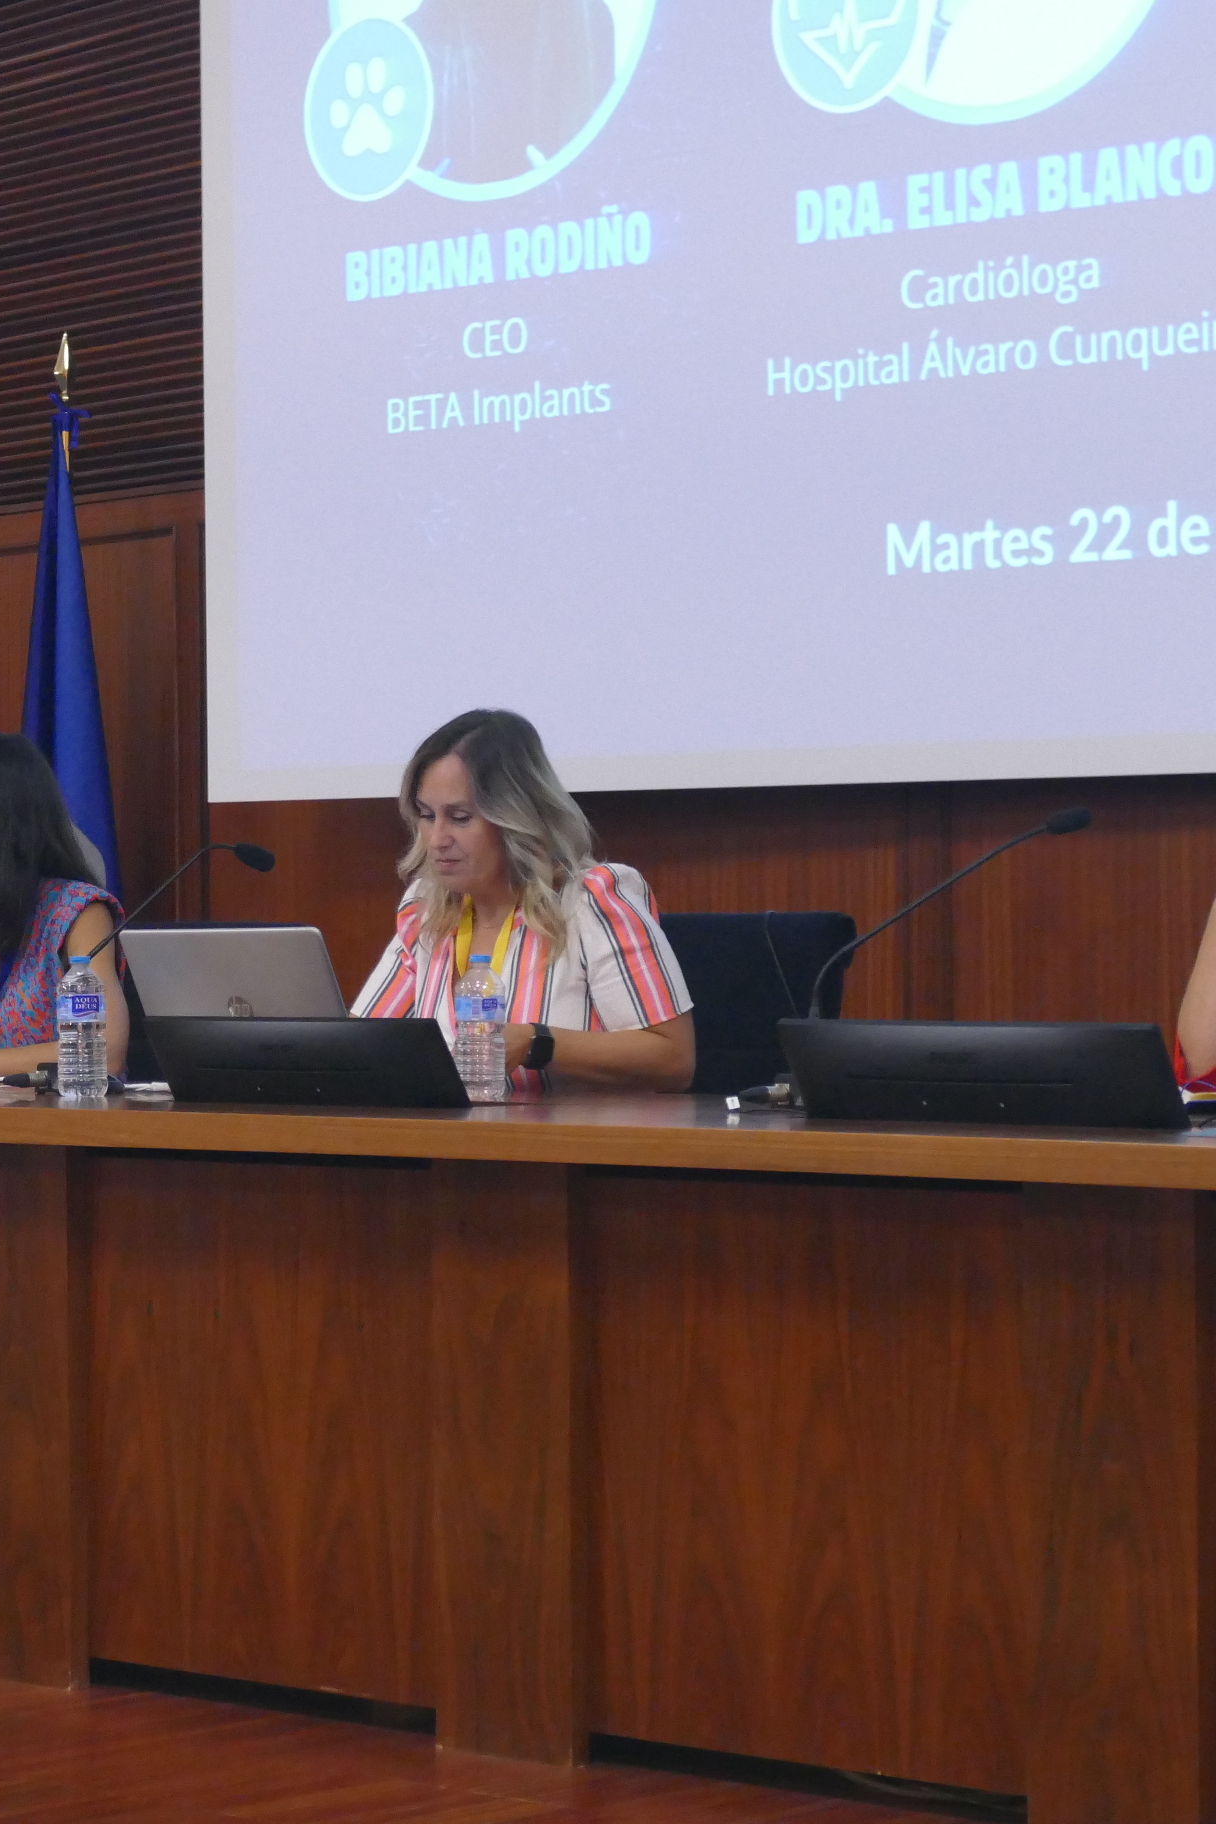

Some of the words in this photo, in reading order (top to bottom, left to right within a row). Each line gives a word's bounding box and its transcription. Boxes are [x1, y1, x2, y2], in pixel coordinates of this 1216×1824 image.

[796, 180, 895, 244] DRA.
[906, 160, 1025, 230] ELISA
[1037, 134, 1214, 212] BLANCO
[346, 231, 494, 302] BIBIANA
[505, 205, 651, 280] RODIÑO
[902, 255, 1102, 308] Cardióloga
[462, 317, 529, 358] CEO
[768, 342, 911, 401] Hospital
[920, 329, 1038, 379] Álvaro
[1050, 310, 1216, 371] Cunquei
[388, 393, 464, 434] BETA
[474, 381, 612, 432] Implants
[886, 519, 1056, 575] Martes
[1070, 505, 1135, 564] 22
[1147, 499, 1212, 558] de
